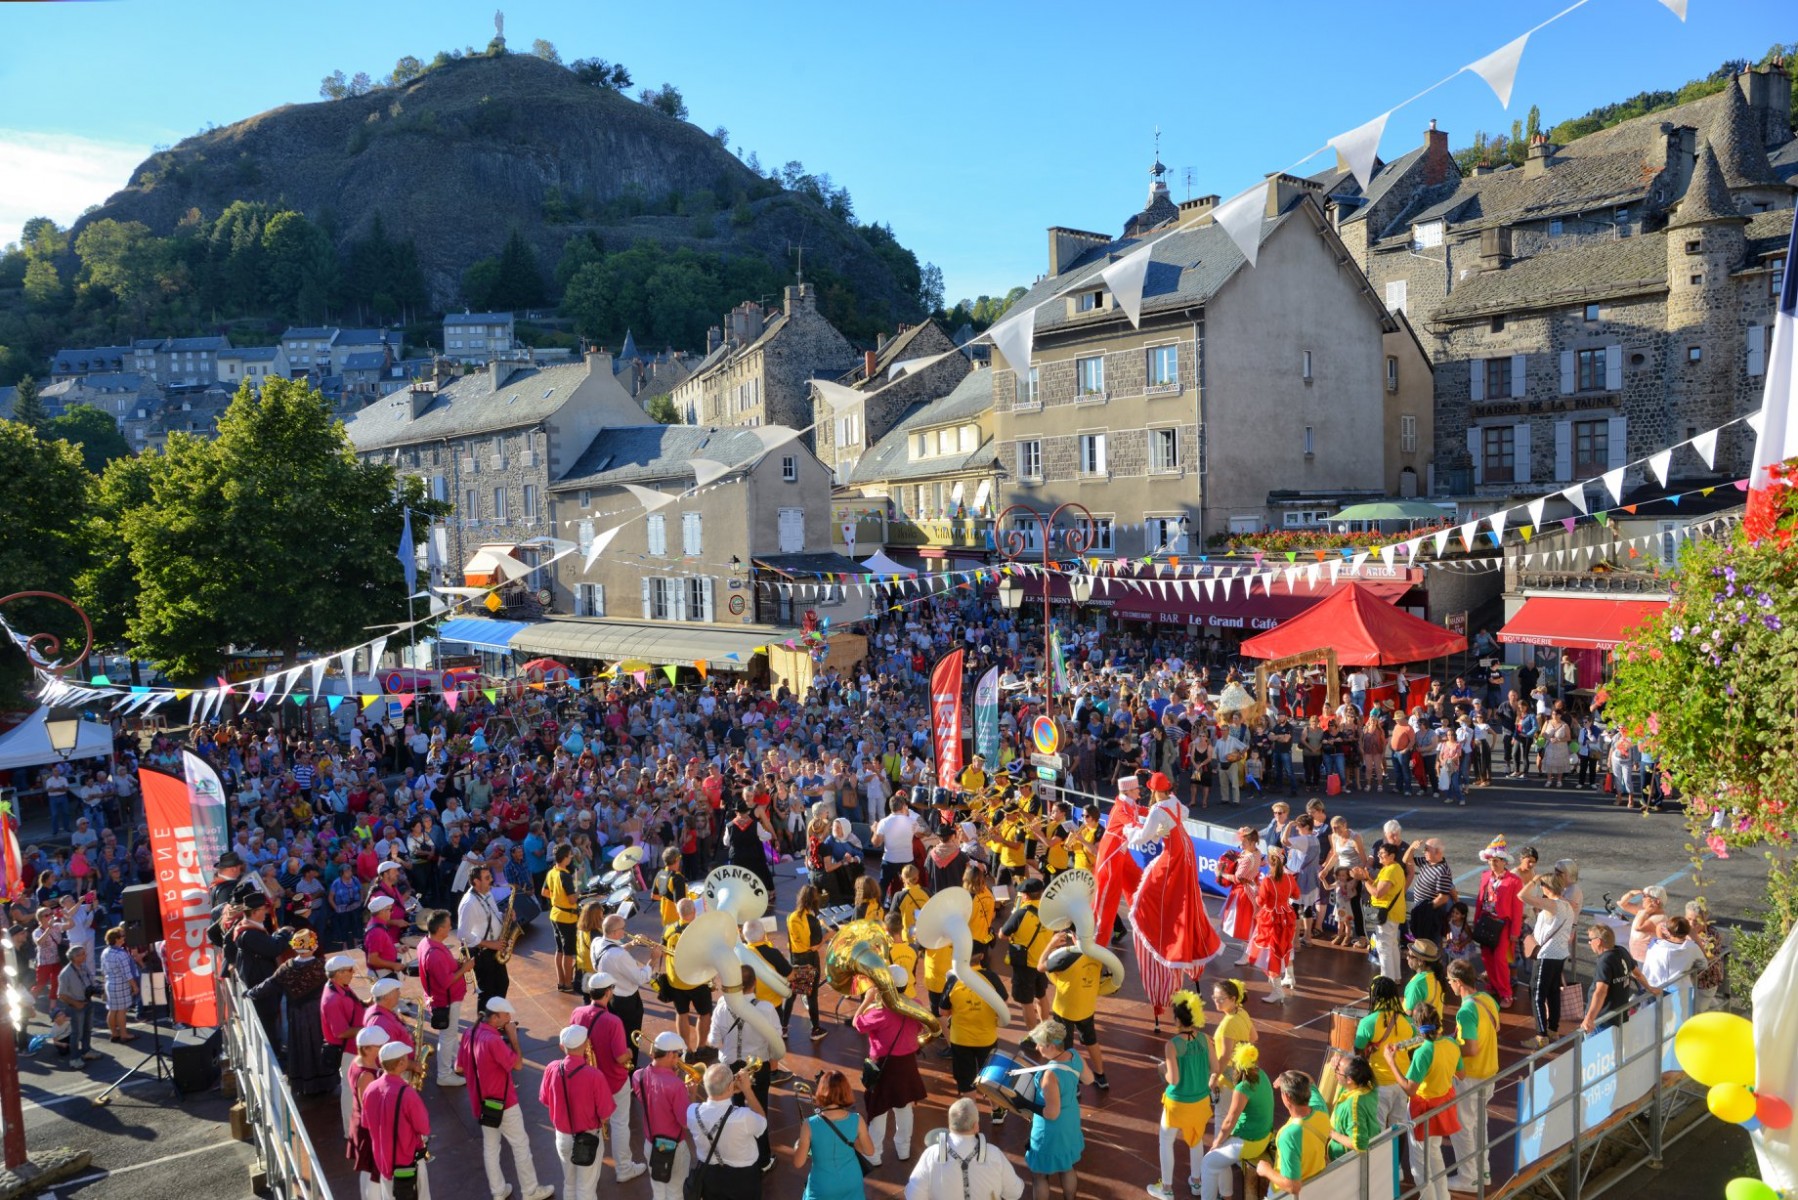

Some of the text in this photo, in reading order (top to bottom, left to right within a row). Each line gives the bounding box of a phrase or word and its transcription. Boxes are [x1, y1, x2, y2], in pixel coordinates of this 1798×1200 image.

[1475, 403, 1520, 416] MAISON
[1528, 400, 1544, 412] DE
[1552, 400, 1566, 411] LA
[1366, 566, 1397, 578] ARTOIS
[1160, 612, 1278, 629] BAR Le Grand Café
[1502, 635, 1553, 647] BOULANGERIE
[1595, 642, 1613, 651] AUX
[713, 868, 764, 897] VANOSC
